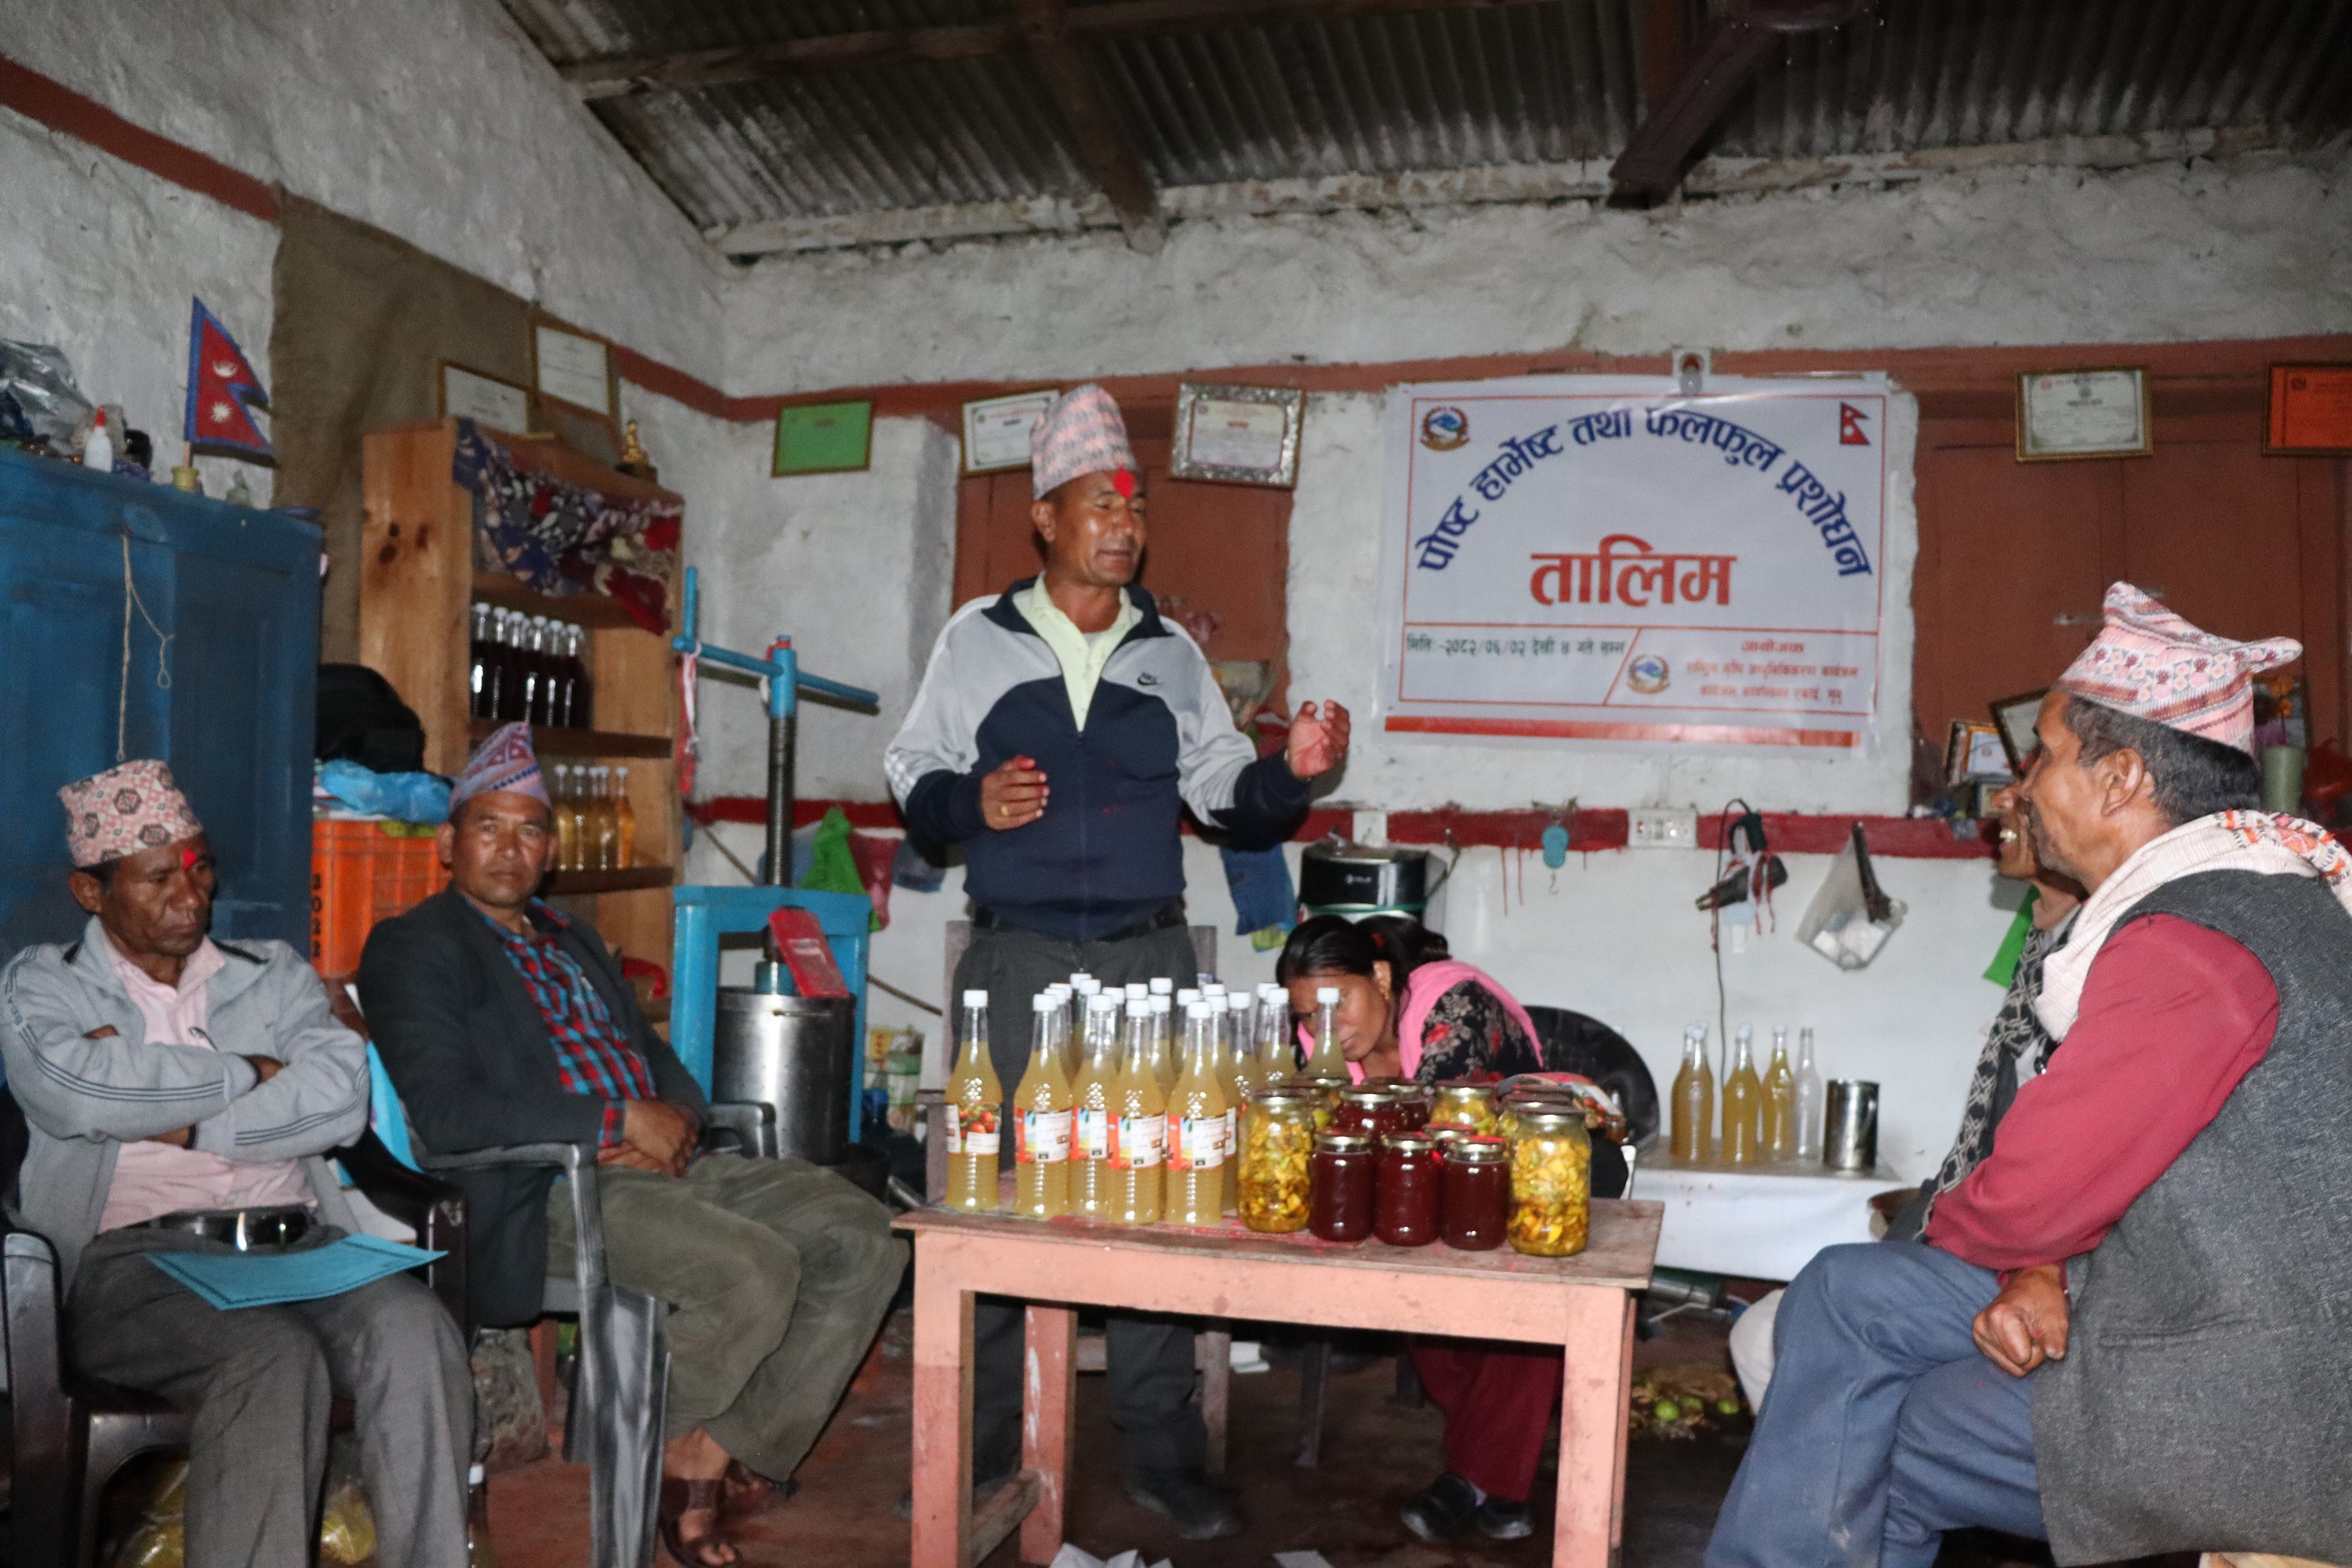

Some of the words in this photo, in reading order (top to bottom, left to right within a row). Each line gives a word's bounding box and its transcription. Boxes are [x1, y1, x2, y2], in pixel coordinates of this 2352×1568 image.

[1414, 495, 1480, 571] पोष्ट
[1568, 407, 1632, 446] तथा
[1644, 407, 1786, 473] फलफुल
[1775, 459, 1873, 577] प्रशोधन
[1530, 533, 1738, 608] तालिम
